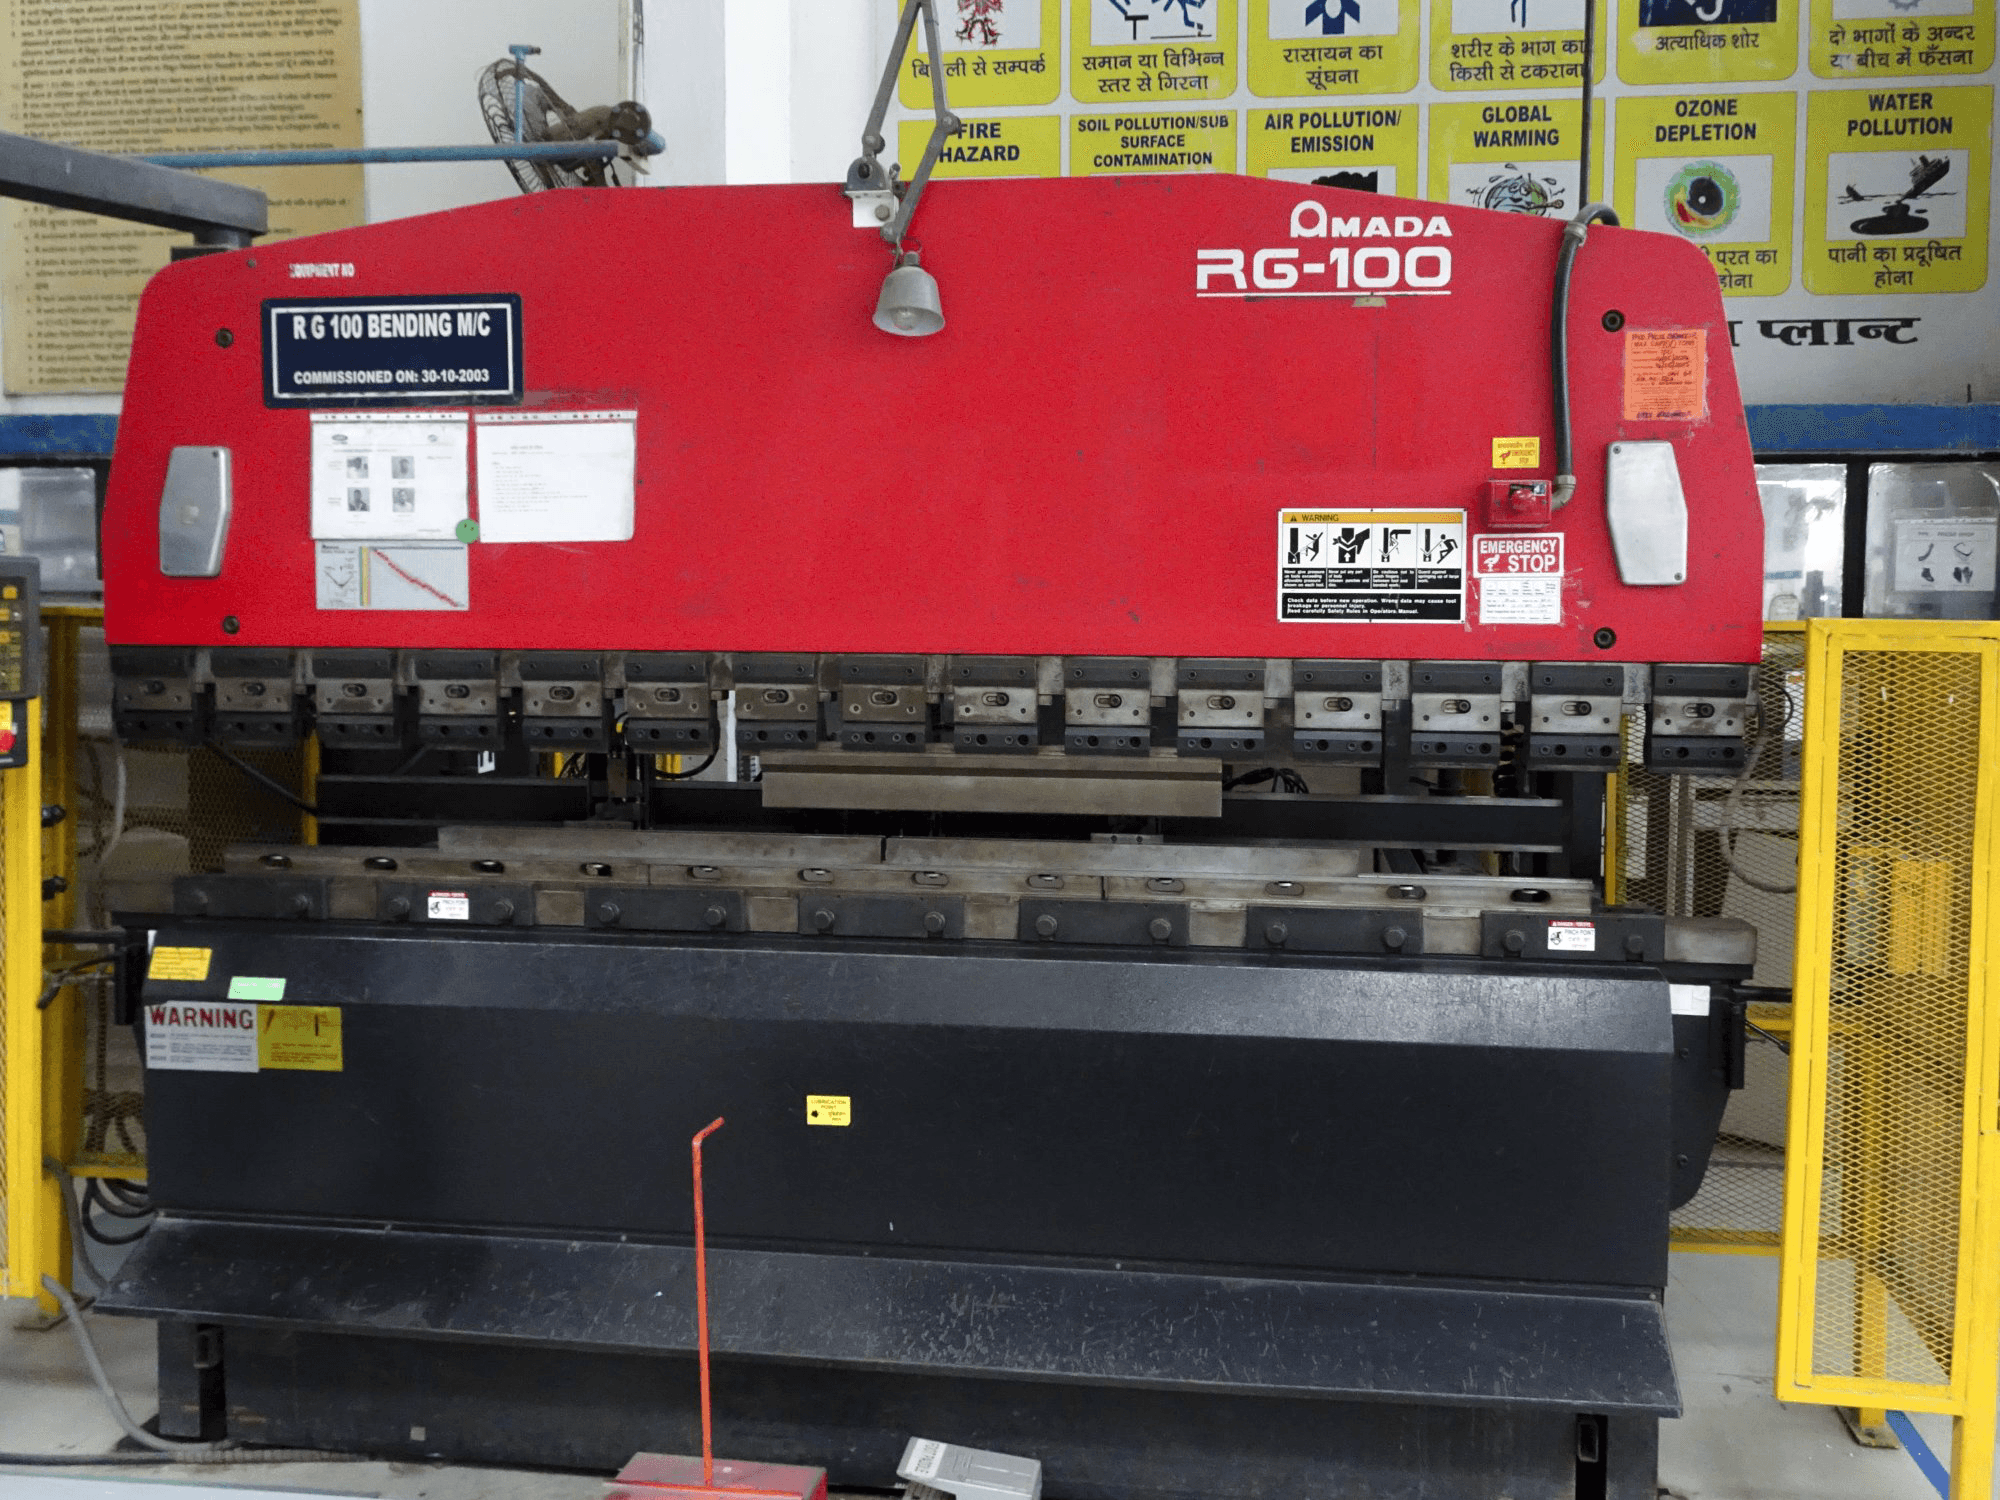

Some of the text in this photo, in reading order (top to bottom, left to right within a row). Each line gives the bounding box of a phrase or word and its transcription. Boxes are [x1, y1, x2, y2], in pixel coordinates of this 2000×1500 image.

[1655, 26, 1760, 51] अत्याधिक शोर
[1829, 20, 1975, 46] दो भागों के अन्दर
[1282, 45, 1383, 63] रासायन का
[1451, 36, 1585, 59] शरीर के भाग का
[1856, 47, 1890, 68] बीच
[1896, 45, 1912, 67] में
[1919, 44, 1974, 66] फँसना
[911, 52, 1046, 79] बिली से सम्पर्क
[1082, 47, 1225, 71] समान या विभिन्न
[1305, 65, 1359, 91] सूंघना
[1449, 60, 1494, 82] किसी
[1500, 59, 1515, 80] से
[1097, 70, 1209, 93] स्तर से गिरना
[1675, 99, 1738, 118] OZONE
[1868, 92, 1933, 112] WATER
[1077, 115, 1229, 132] SOIL POLLUTION/SUB
[1264, 110, 1402, 130] AIR POLLUTION/
[1482, 105, 1552, 124] GLOBAL
[957, 122, 1002, 139] FIRE
[1655, 123, 1757, 143] DEPLETION
[1847, 117, 1953, 137] POLLUTION
[1120, 134, 1185, 149] SURFACE
[1291, 134, 1374, 153] EMISSION
[1473, 128, 1560, 149] WARMING
[939, 145, 1020, 163] HAZARD
[1093, 152, 1213, 168] CONTAMINATION
[1290, 200, 1453, 238] AMADA
[1716, 250, 1750, 266] परत
[1755, 249, 1778, 265] का
[1828, 240, 1962, 268] पानी का प्रदूषित
[1196, 246, 1452, 290] RG-100
[1874, 264, 1914, 289] होना
[292, 311, 491, 340] R G 100 BENDING M/C
[1756, 317, 1922, 347] प्लान्ट
[293, 368, 490, 385] COMMISSIONED ON: 30-10-2003
[1301, 513, 1340, 522] WARNING
[1480, 539, 1558, 554] EMERGENCY
[1507, 553, 1556, 572] STOP
[150, 1006, 254, 1029] WARNING
